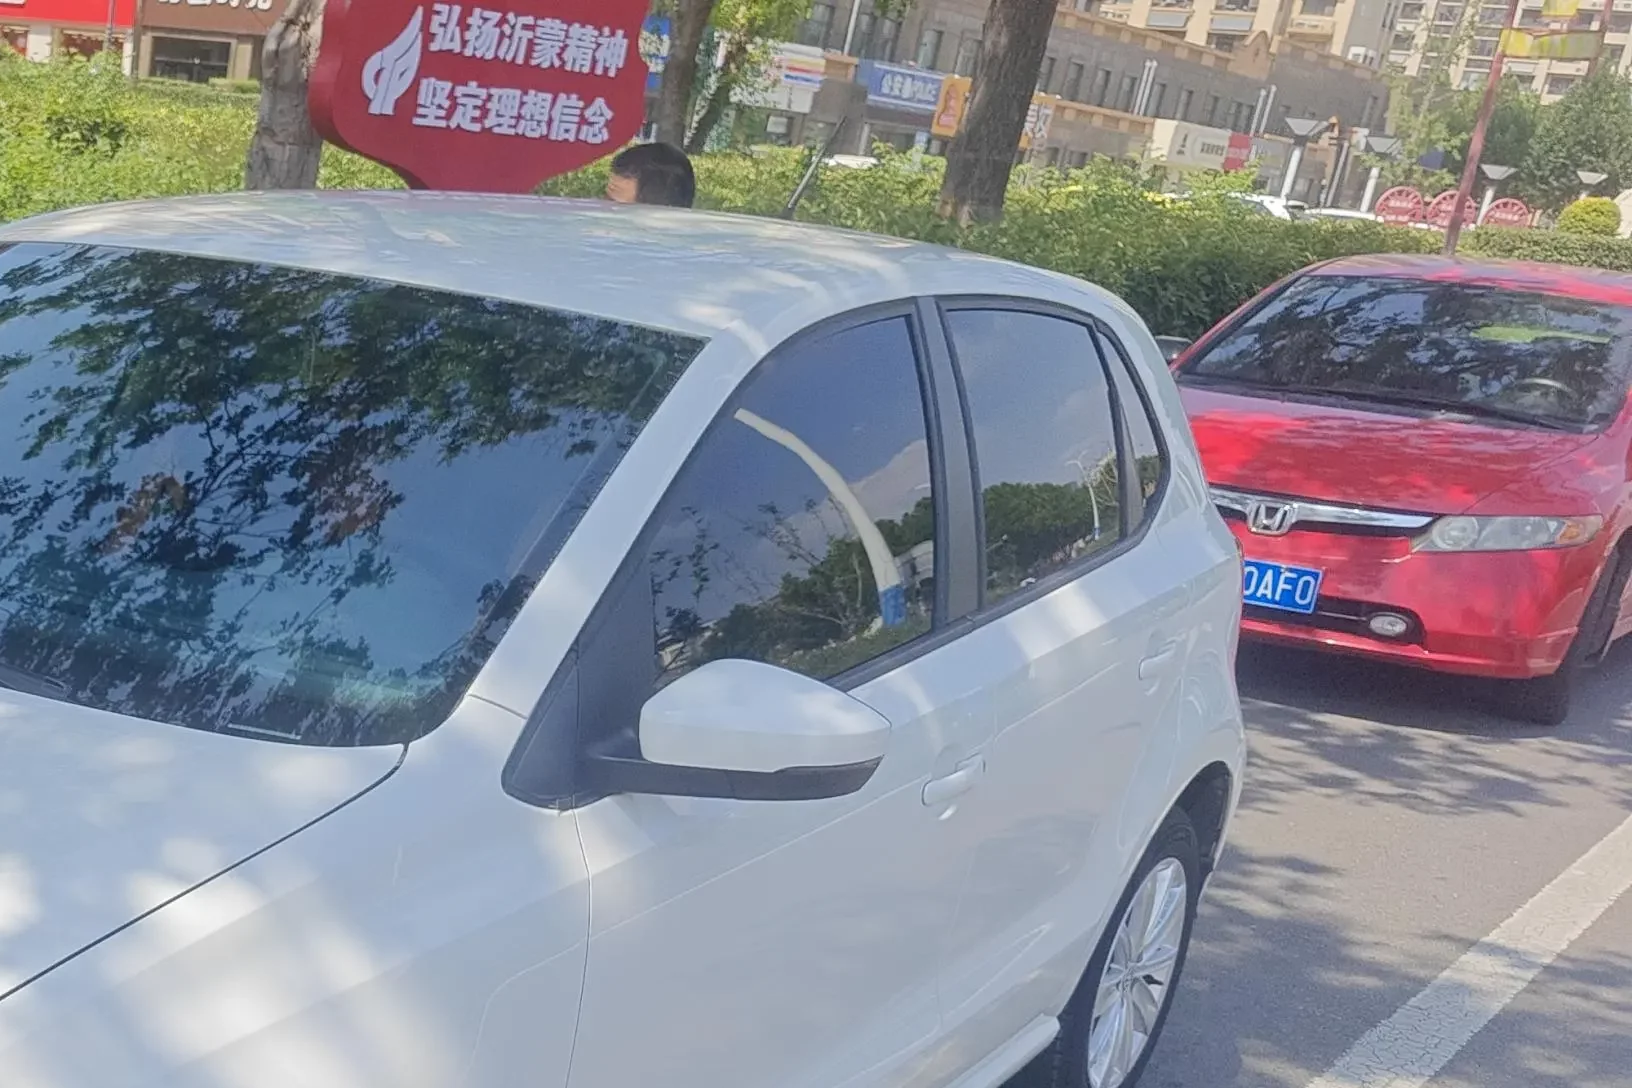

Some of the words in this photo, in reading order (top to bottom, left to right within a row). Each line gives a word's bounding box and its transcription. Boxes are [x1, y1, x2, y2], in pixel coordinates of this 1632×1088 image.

[428, 3, 628, 77] 弘扬沂蒙精神
[413, 78, 614, 144] 坚定理想信念
